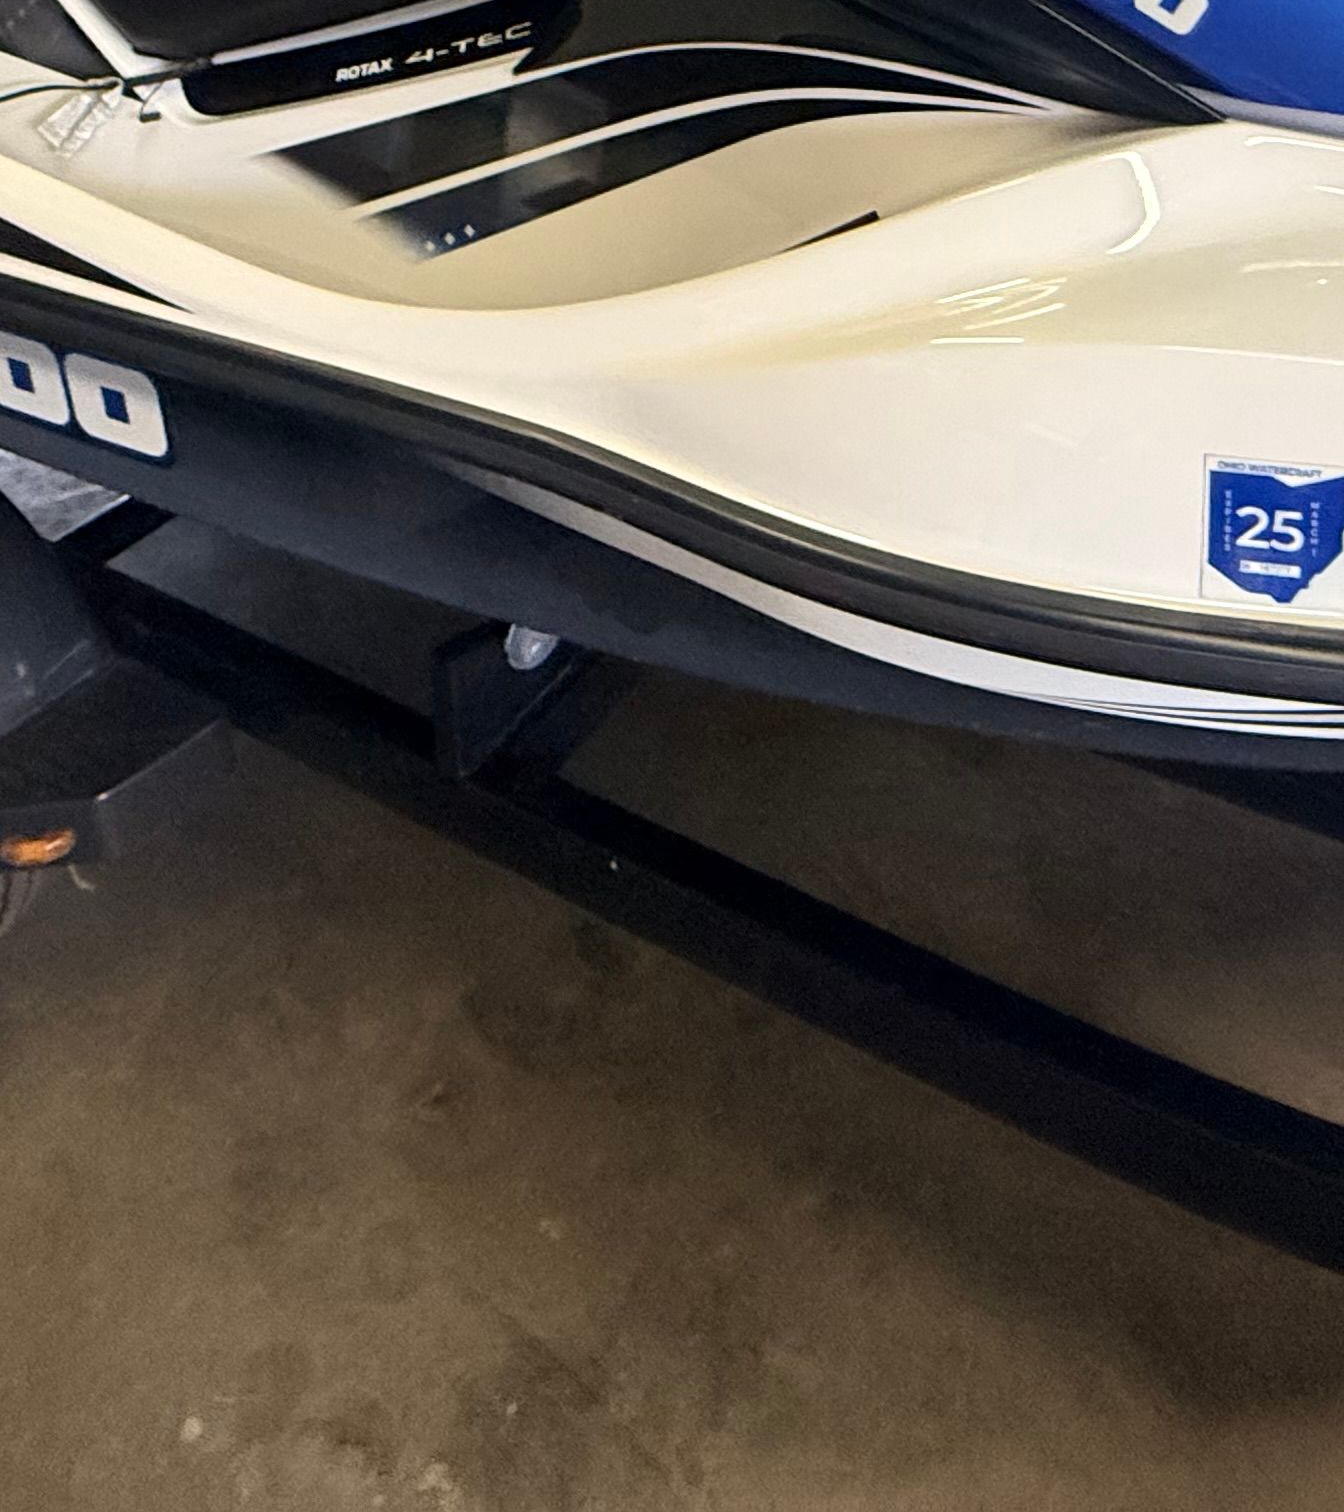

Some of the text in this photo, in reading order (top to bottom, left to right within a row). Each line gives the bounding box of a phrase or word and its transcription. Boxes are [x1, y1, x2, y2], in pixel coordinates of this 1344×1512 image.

[335, 21, 534, 82] ROTAX 4-TEC
[1217, 460, 1246, 470] OHIO
[1236, 506, 1305, 552] 25
